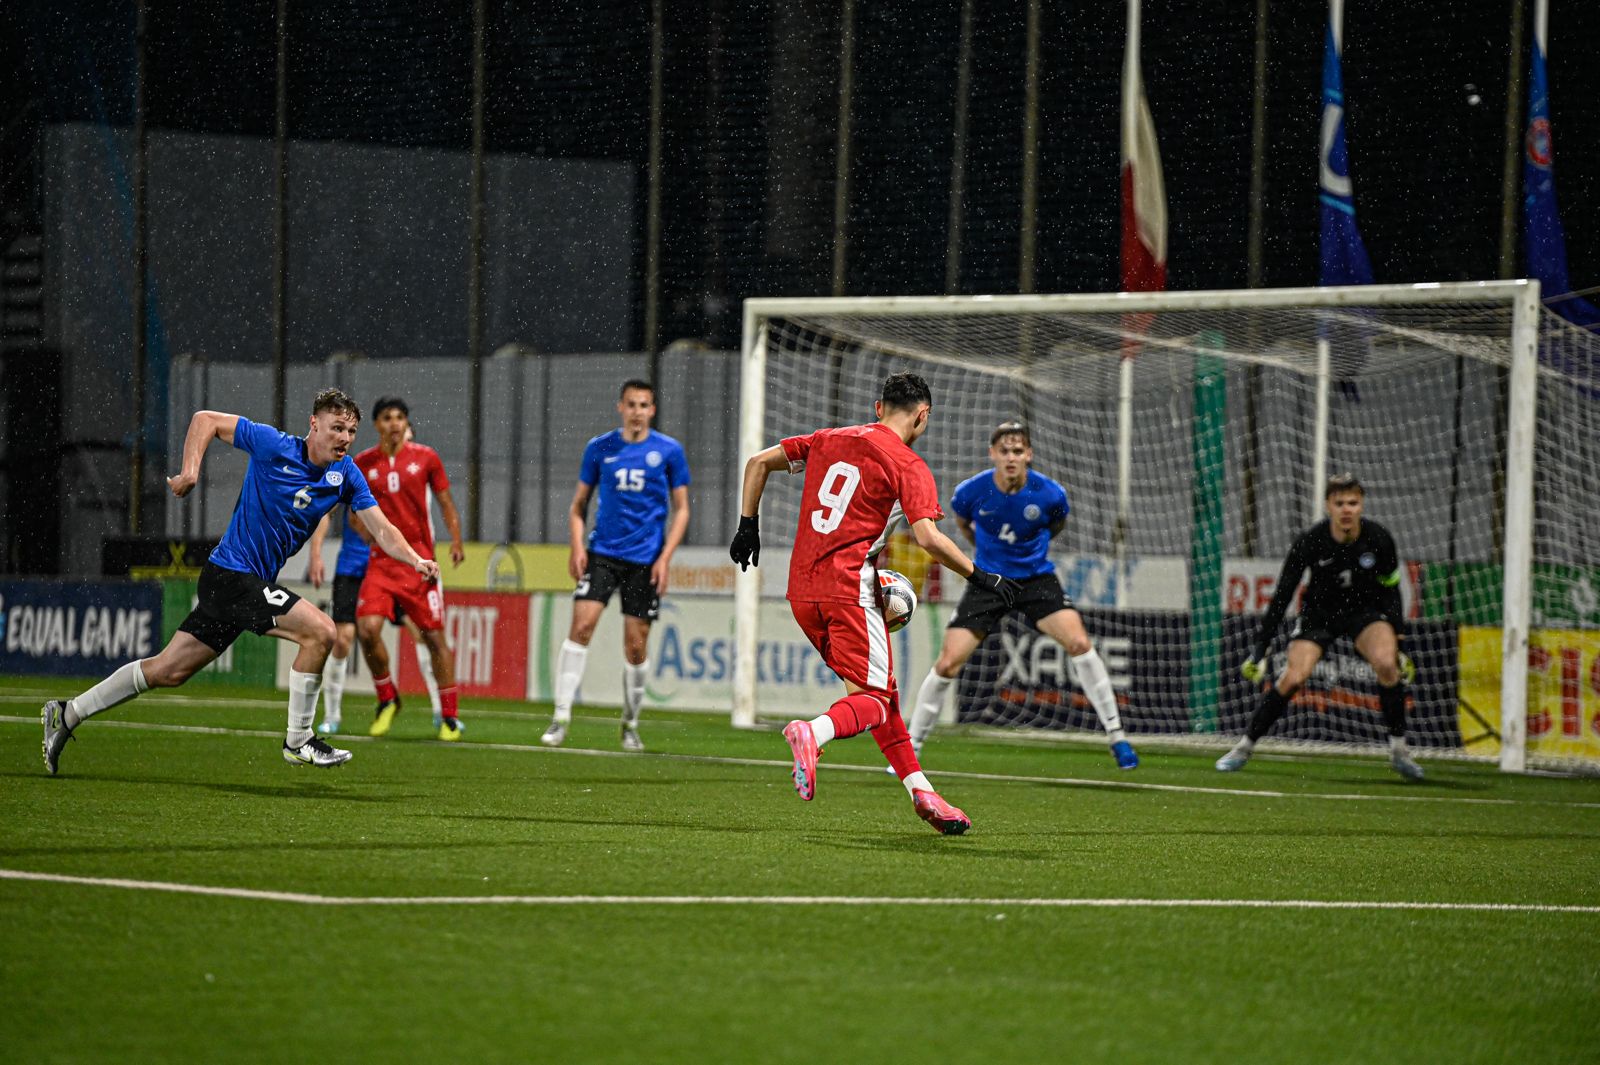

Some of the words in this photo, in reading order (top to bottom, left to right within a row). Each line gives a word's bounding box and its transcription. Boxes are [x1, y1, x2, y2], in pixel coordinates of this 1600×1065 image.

[387, 471, 400, 493] 8
[615, 468, 646, 491] 15
[293, 485, 312, 510] 6
[811, 461, 860, 535] 9
[998, 523, 1017, 545] 4
[263, 586, 290, 607] 6
[1000, 632, 1133, 688] XAE
